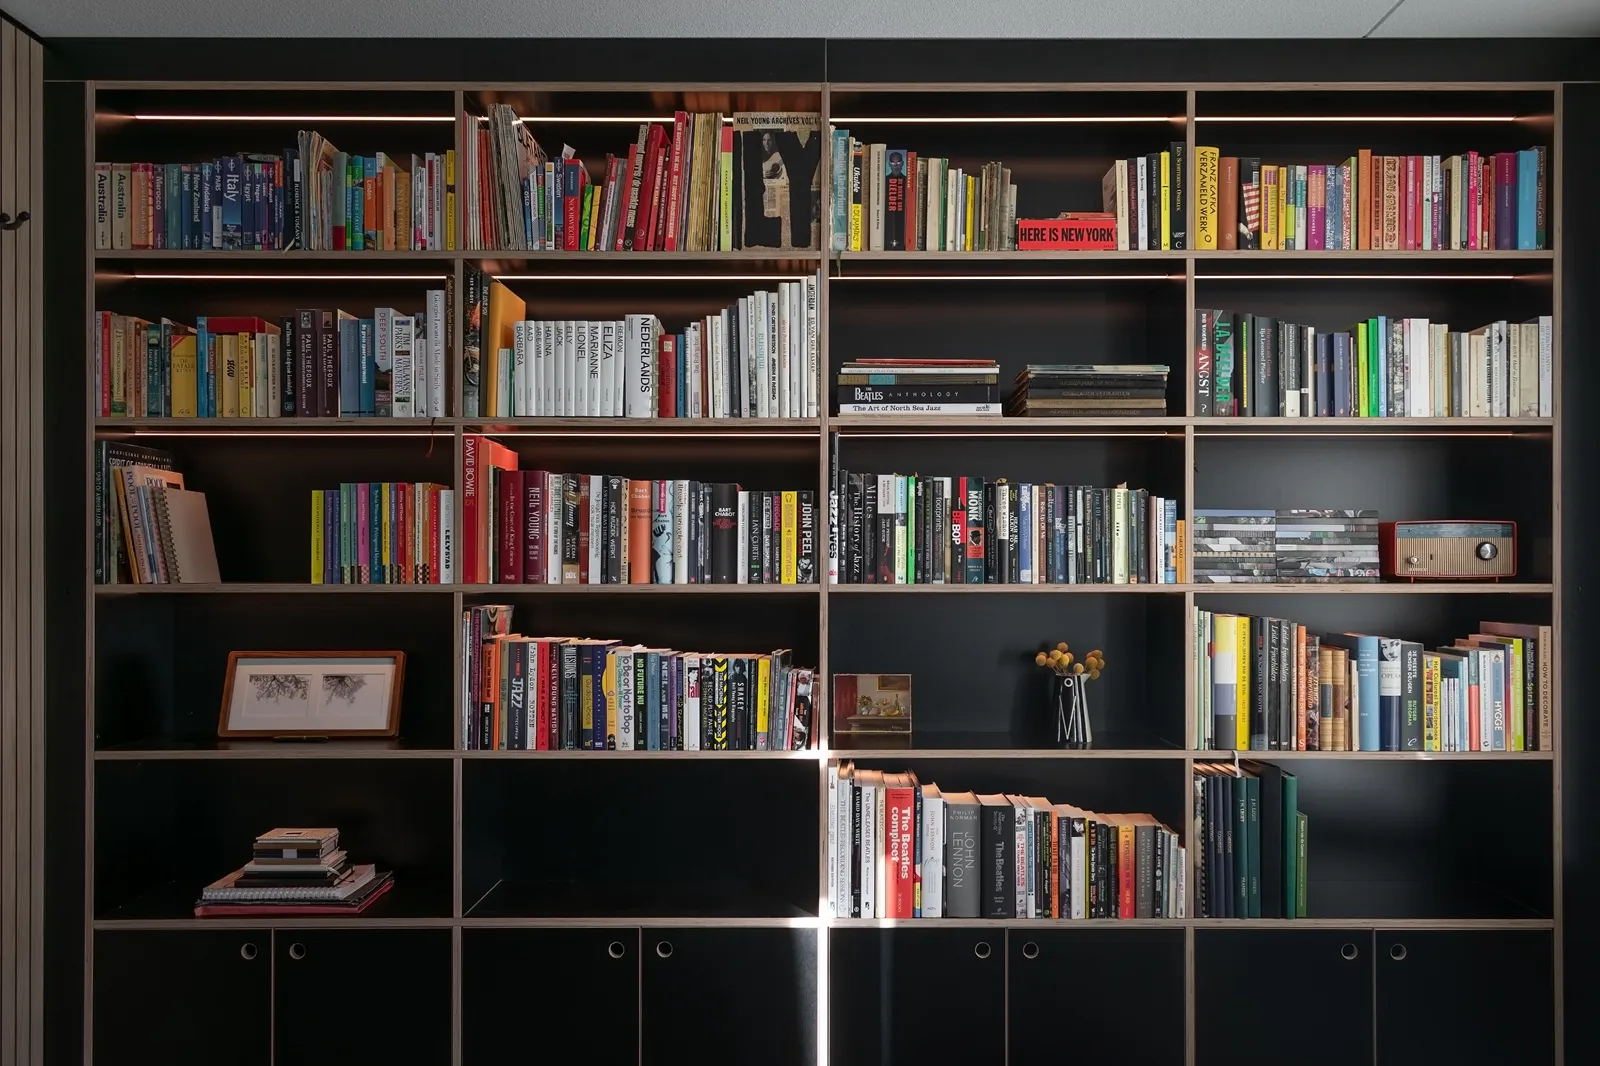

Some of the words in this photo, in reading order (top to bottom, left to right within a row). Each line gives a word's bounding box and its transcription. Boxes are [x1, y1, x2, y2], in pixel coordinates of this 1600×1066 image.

[736, 117, 749, 125] NEIL
[751, 117, 770, 125] YOUNG
[772, 115, 799, 125] ARCHIVES
[636, 125, 648, 153] desmond
[634, 154, 644, 176] morris
[98, 174, 107, 223] Australia
[118, 173, 126, 218] Australia
[224, 174, 239, 201] Italy
[629, 187, 640, 209] naakte
[838, 175, 846, 216] Nederland
[889, 179, 897, 211] DEELDER
[627, 210, 636, 227] mens
[1020, 228, 1046, 242] HERE
[1049, 228, 1058, 242] IS
[1061, 228, 1084, 242] NEW
[1086, 228, 1114, 242] YORK
[577, 326, 585, 362] LIONEL
[603, 326, 613, 360] ELIZA
[1216, 322, 1231, 341] J.A.
[590, 326, 598, 378] MARIANNE
[640, 318, 650, 392] NEDERLANDS
[1199, 353, 1209, 397] ANGST
[1216, 344, 1232, 402] DEELDER
[854, 388, 883, 402] BEATLES
[466, 439, 474, 466] DAVID
[466, 468, 474, 496] BOWIE
[126, 471, 136, 496] POOL
[131, 505, 140, 532] POOL
[529, 488, 540, 508] NEIL
[866, 484, 876, 519] Miles
[968, 490, 978, 521] MONK
[529, 511, 540, 539] YOUNG
[802, 502, 812, 528] JOHN
[852, 507, 862, 543] History
[952, 510, 961, 545] BEBOP
[751, 536, 759, 560] CURTIS
[802, 531, 812, 556] PEEL
[853, 544, 862, 552] of
[853, 554, 862, 573] Jazz
[564, 647, 576, 678] MILESTONES
[623, 655, 632, 664] To
[623, 666, 632, 677] Be
[637, 659, 644, 668] NO
[512, 678, 523, 708] JAZZ
[623, 678, 630, 686] or
[623, 688, 632, 703] Not
[1543, 681, 1548, 689] TO
[623, 705, 631, 713] to
[638, 693, 644, 704] NU
[662, 705, 668, 719] ME
[622, 715, 632, 734] Bop
[902, 807, 910, 831] The
[890, 807, 900, 862] compleet
[902, 834, 910, 879] Beatles
[953, 832, 963, 888] LENNON
[964, 832, 974, 868] JOHN
[996, 842, 1004, 858] The
[996, 859, 1004, 892] Beatles
